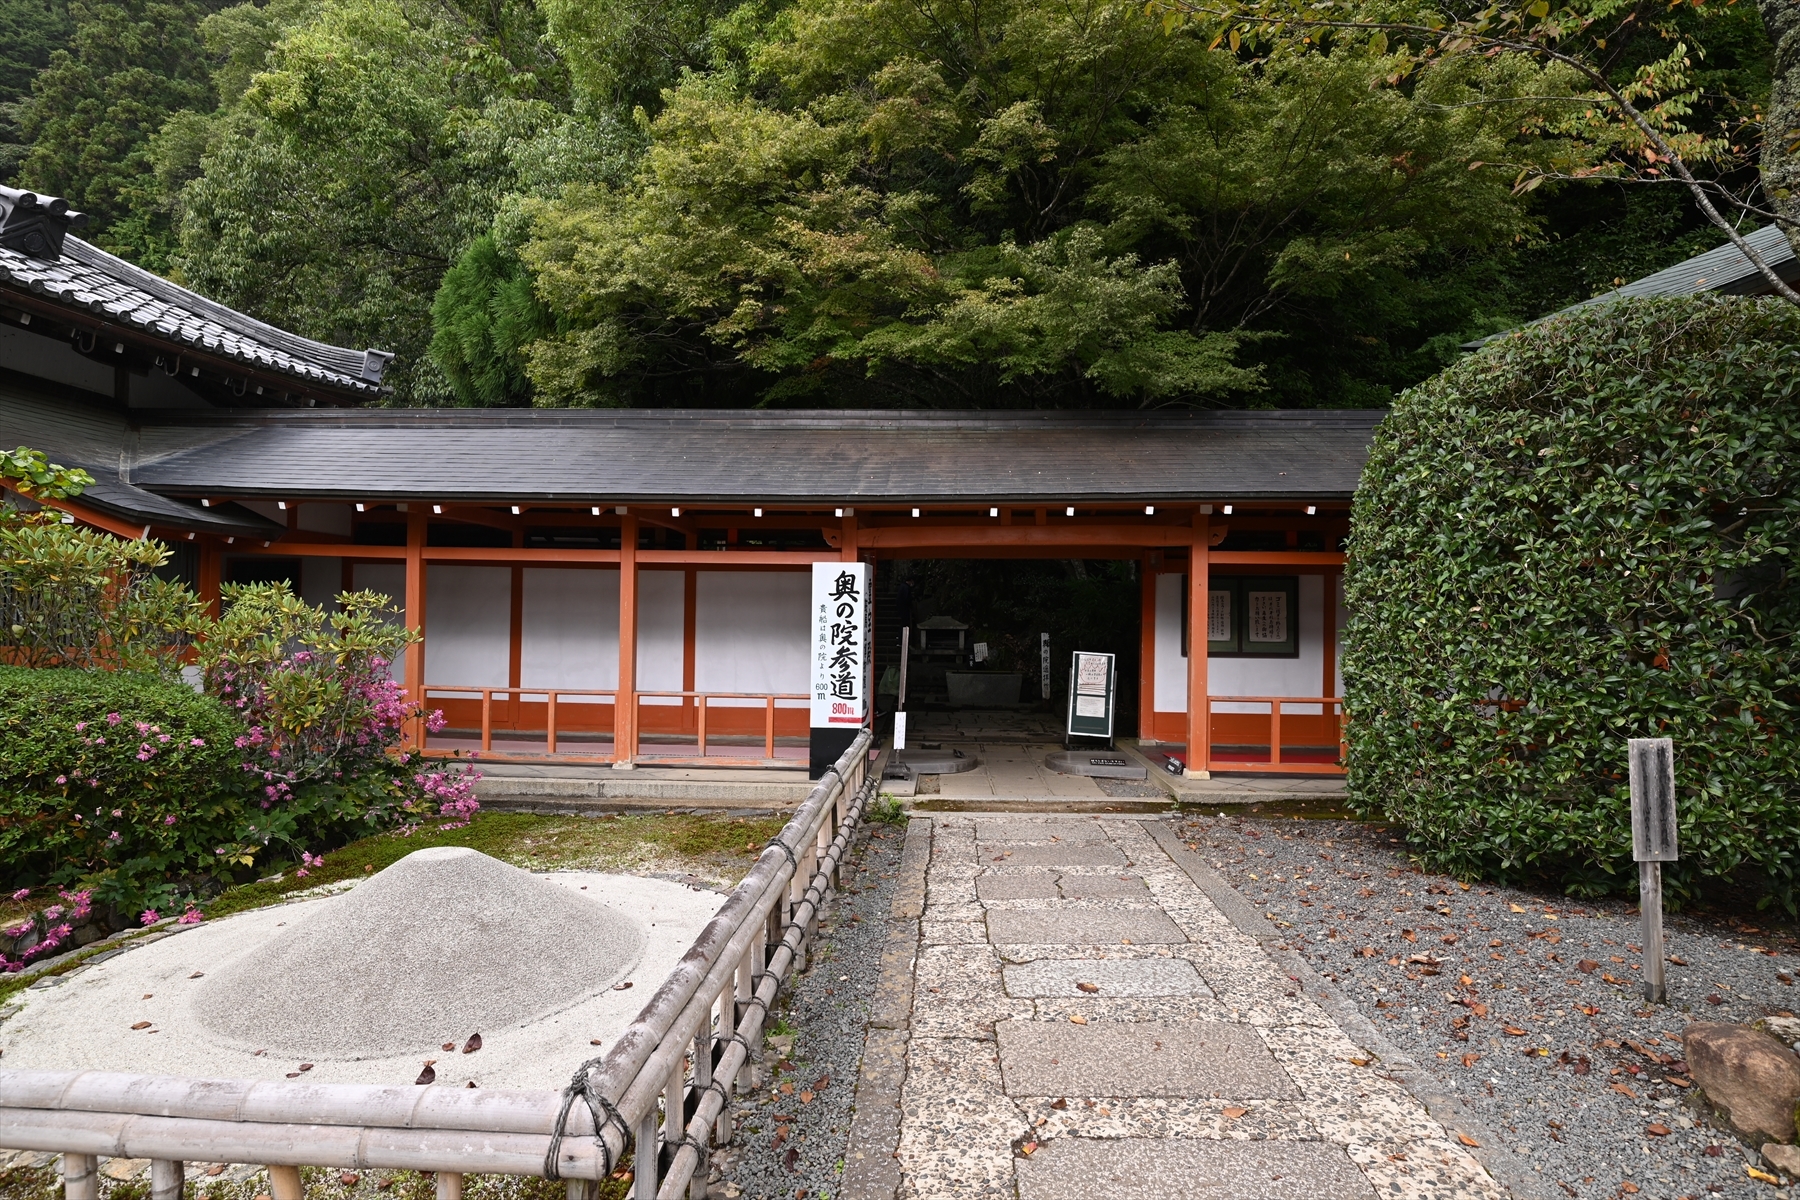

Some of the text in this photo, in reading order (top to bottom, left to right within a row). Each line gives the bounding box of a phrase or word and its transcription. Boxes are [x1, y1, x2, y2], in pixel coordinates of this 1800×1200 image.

[828, 570, 860, 700] 奥の院参道
[832, 703, 854, 715] 800m
